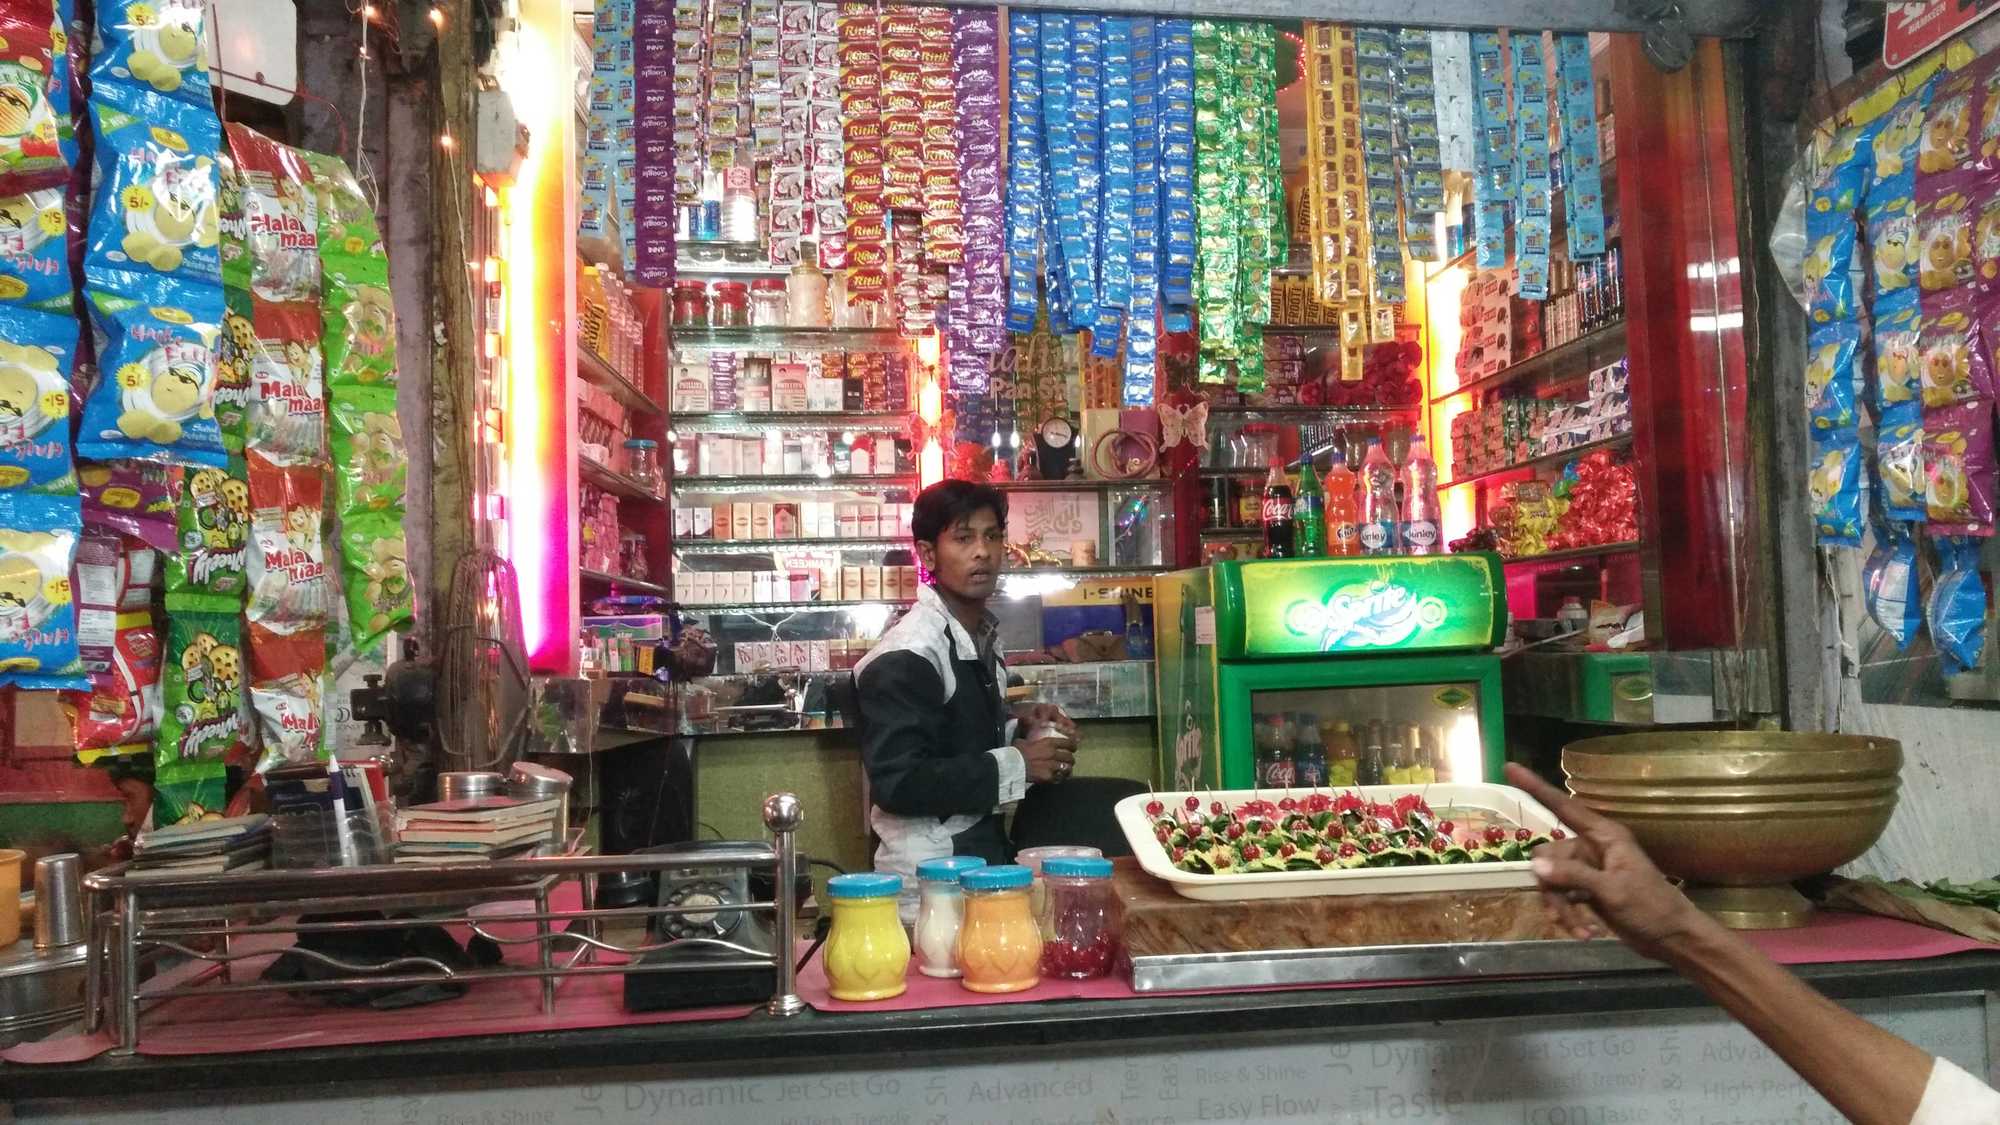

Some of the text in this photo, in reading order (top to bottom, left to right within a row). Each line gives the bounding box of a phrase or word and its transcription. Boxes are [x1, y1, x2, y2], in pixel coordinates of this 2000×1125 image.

[129, 196, 150, 209] 5/-
[43, 210, 62, 224] 5/-
[45, 393, 65, 407] 5/-
[260, 381, 304, 400] Mala
[264, 550, 306, 569] Mala
[50, 579, 69, 592] 5/-
[1602, 1035, 1636, 1058] Go
[818, 1075, 857, 1100] Set
[864, 1073, 902, 1097] Go
[967, 1072, 1095, 1104] Advanced
[623, 1080, 767, 1118] Dynamic
[1197, 1095, 1253, 1122] Easy
[1259, 1090, 1321, 1117] Flow
[1364, 1085, 1466, 1120] Taste
